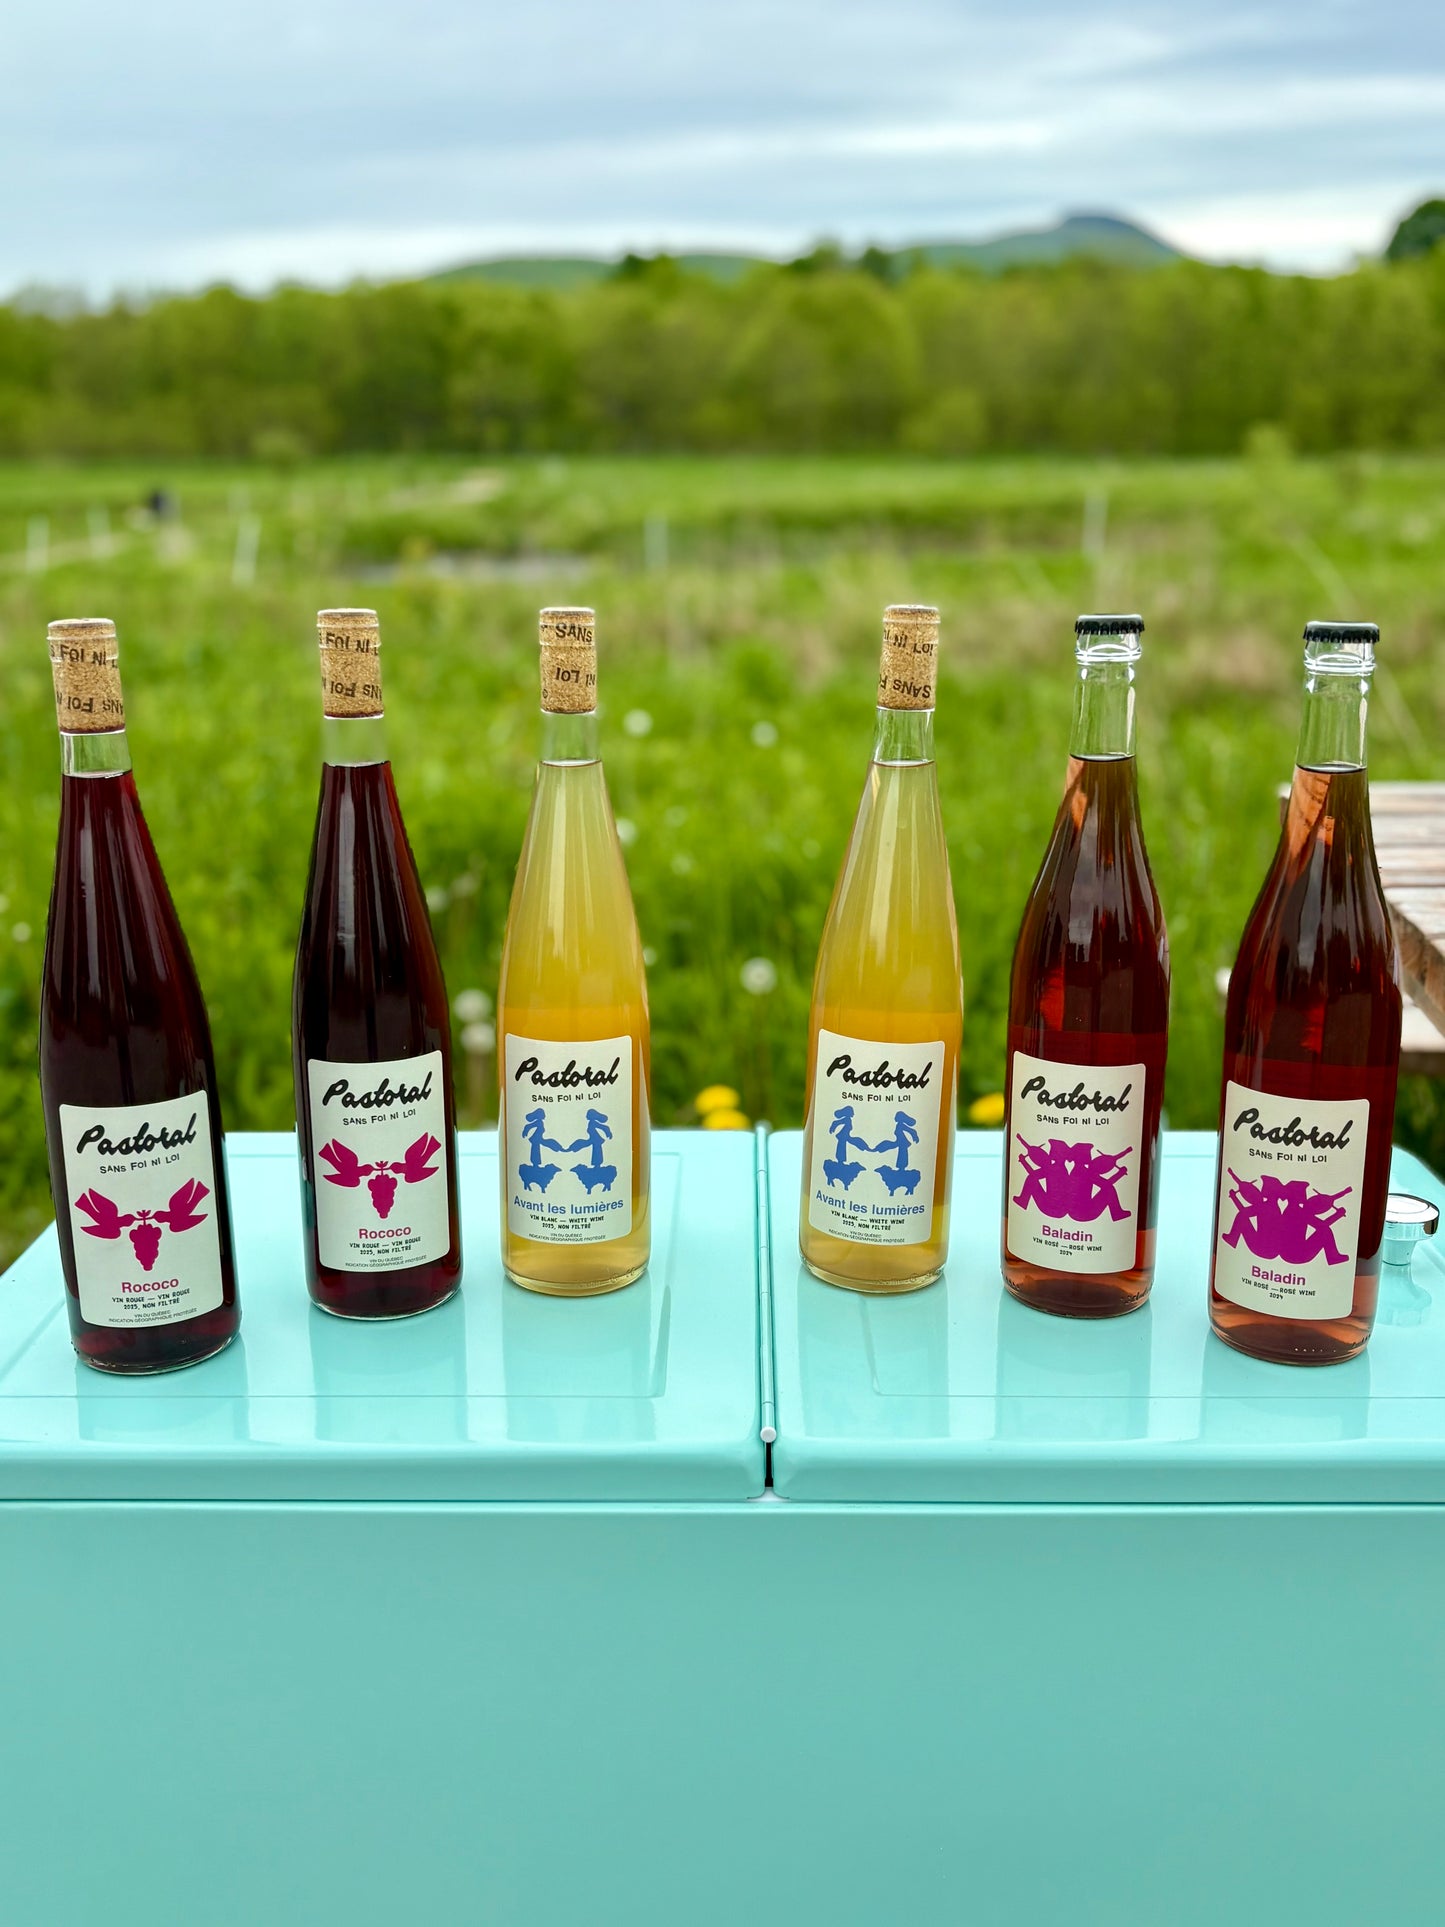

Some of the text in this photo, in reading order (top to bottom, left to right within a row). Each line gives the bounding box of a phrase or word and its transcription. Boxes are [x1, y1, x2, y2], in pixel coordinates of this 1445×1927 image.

[555, 622, 593, 643] SANS
[356, 639, 370, 653] NI
[60, 645, 84, 662] FOI
[92, 648, 107, 666] NI
[331, 681, 357, 697] FOI
[893, 679, 931, 698] SANS
[67, 696, 94, 714] FOI
[515, 1057, 620, 1088] Pastoral
[827, 1055, 932, 1089] Pastoral
[322, 1071, 432, 1108] Pastoral
[588, 1092, 600, 1100] LOI
[842, 1092, 863, 1101] SANS
[868, 1094, 881, 1102] FOI
[1021, 1076, 1132, 1112] Pastoral
[372, 1114, 386, 1124] FOI
[391, 1112, 398, 1120] NI
[403, 1109, 416, 1118] LOI
[1037, 1115, 1059, 1124] SANS
[77, 1113, 196, 1155] Pastoral
[1234, 1108, 1353, 1149] Pastoral
[100, 1154, 179, 1174] SANS FOI NI LOI
[1249, 1148, 1326, 1163] SANS FOI NI LOI
[514, 1195, 623, 1214] Avant les lumières
[816, 1190, 924, 1216] Avant les lumières
[359, 1227, 411, 1239] Rococo
[1042, 1225, 1092, 1242] Baladin
[392, 1245, 411, 1253] FILTRÉ
[1045, 1240, 1058, 1248] ROSÉ
[1242, 1277, 1251, 1285] VIN
[1254, 1282, 1268, 1290] ROSÉ
[1252, 1265, 1306, 1286] Baladin
[122, 1279, 178, 1293] Rococo
[173, 1288, 190, 1296] ROUGE
[159, 1298, 179, 1306] FILTRÉ
